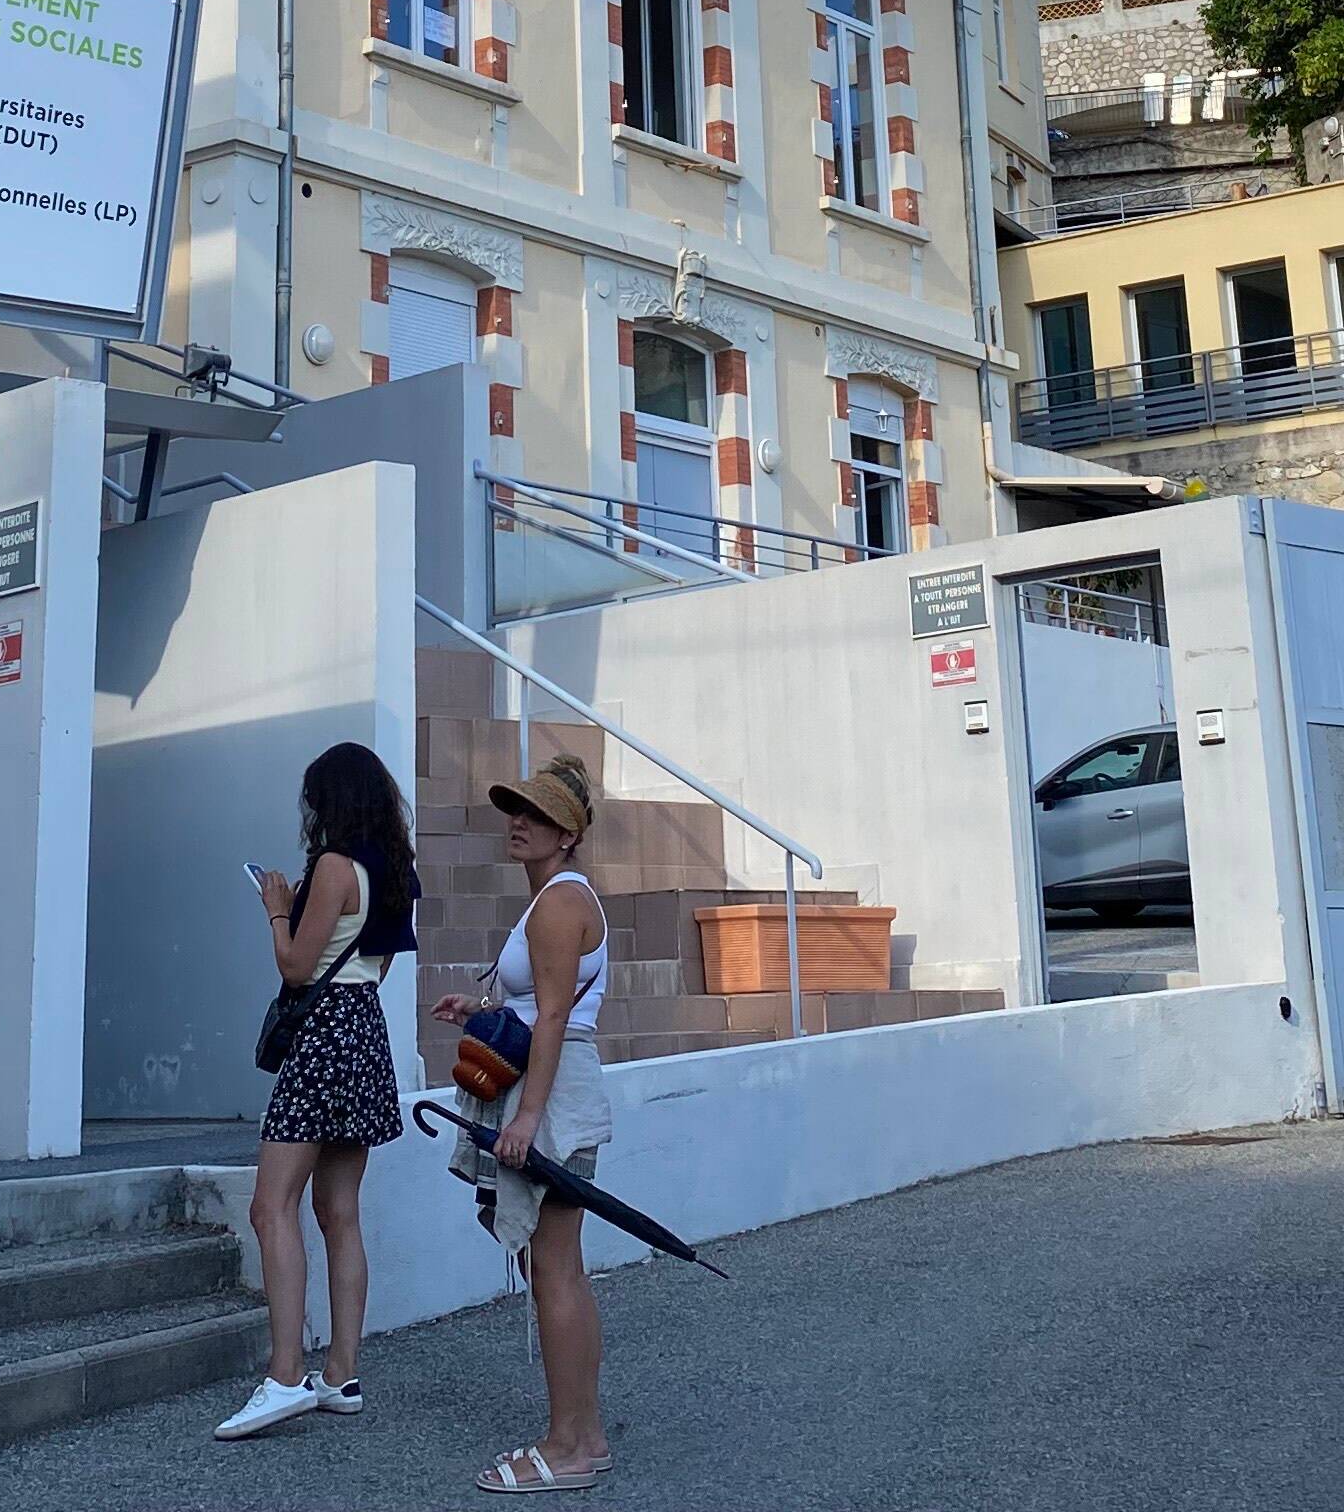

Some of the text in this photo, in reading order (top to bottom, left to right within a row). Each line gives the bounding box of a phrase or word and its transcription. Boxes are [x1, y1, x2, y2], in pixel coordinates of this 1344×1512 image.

[10, 20, 144, 70] SOCIALES
[93, 199, 138, 227] (LP)
[942, 570, 976, 585] INTERDITE
[914, 583, 982, 604] A TOUTE PERSONNE
[927, 599, 968, 615] ETRANGERE
[937, 617, 943, 627] A
